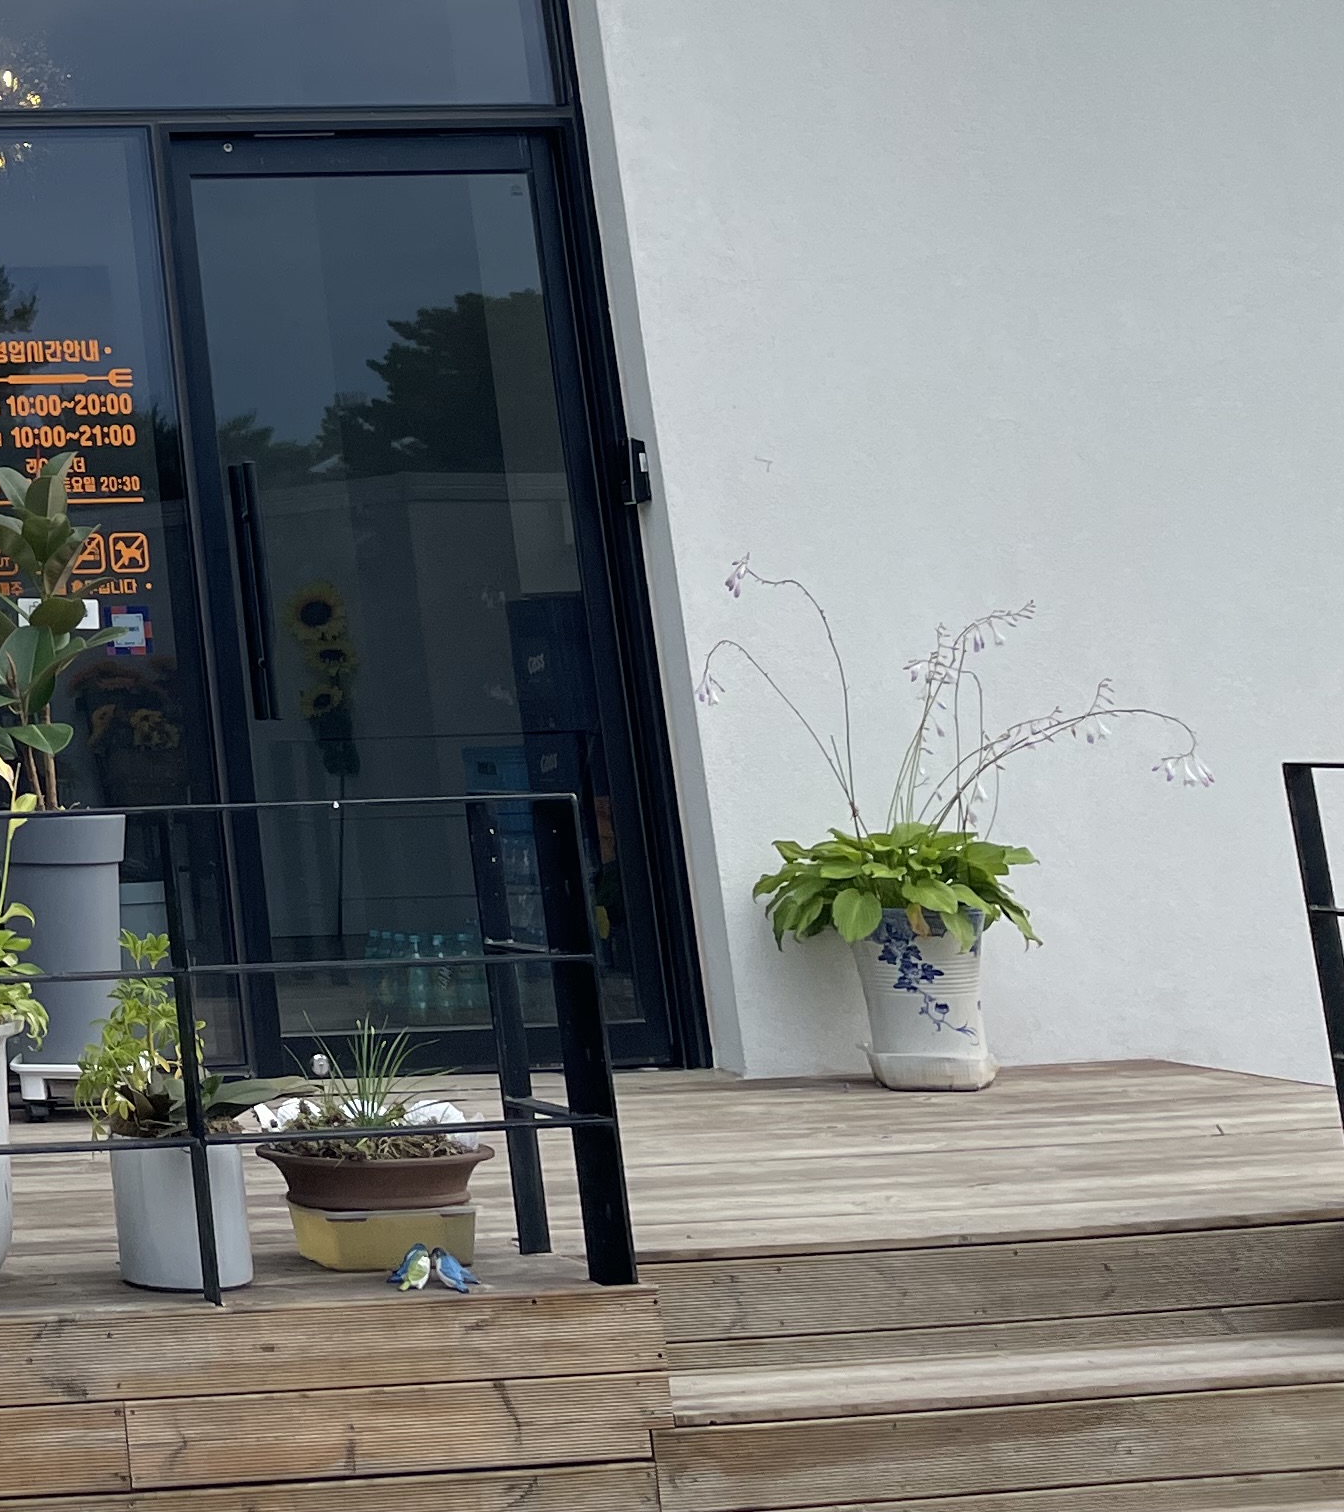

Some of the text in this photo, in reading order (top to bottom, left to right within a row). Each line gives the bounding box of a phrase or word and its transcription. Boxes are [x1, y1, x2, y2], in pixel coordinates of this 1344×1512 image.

[6, 393, 133, 417] 10:00~20:00
[11, 424, 136, 448] 10:00~21:00
[101, 476, 140, 492] 20:30
